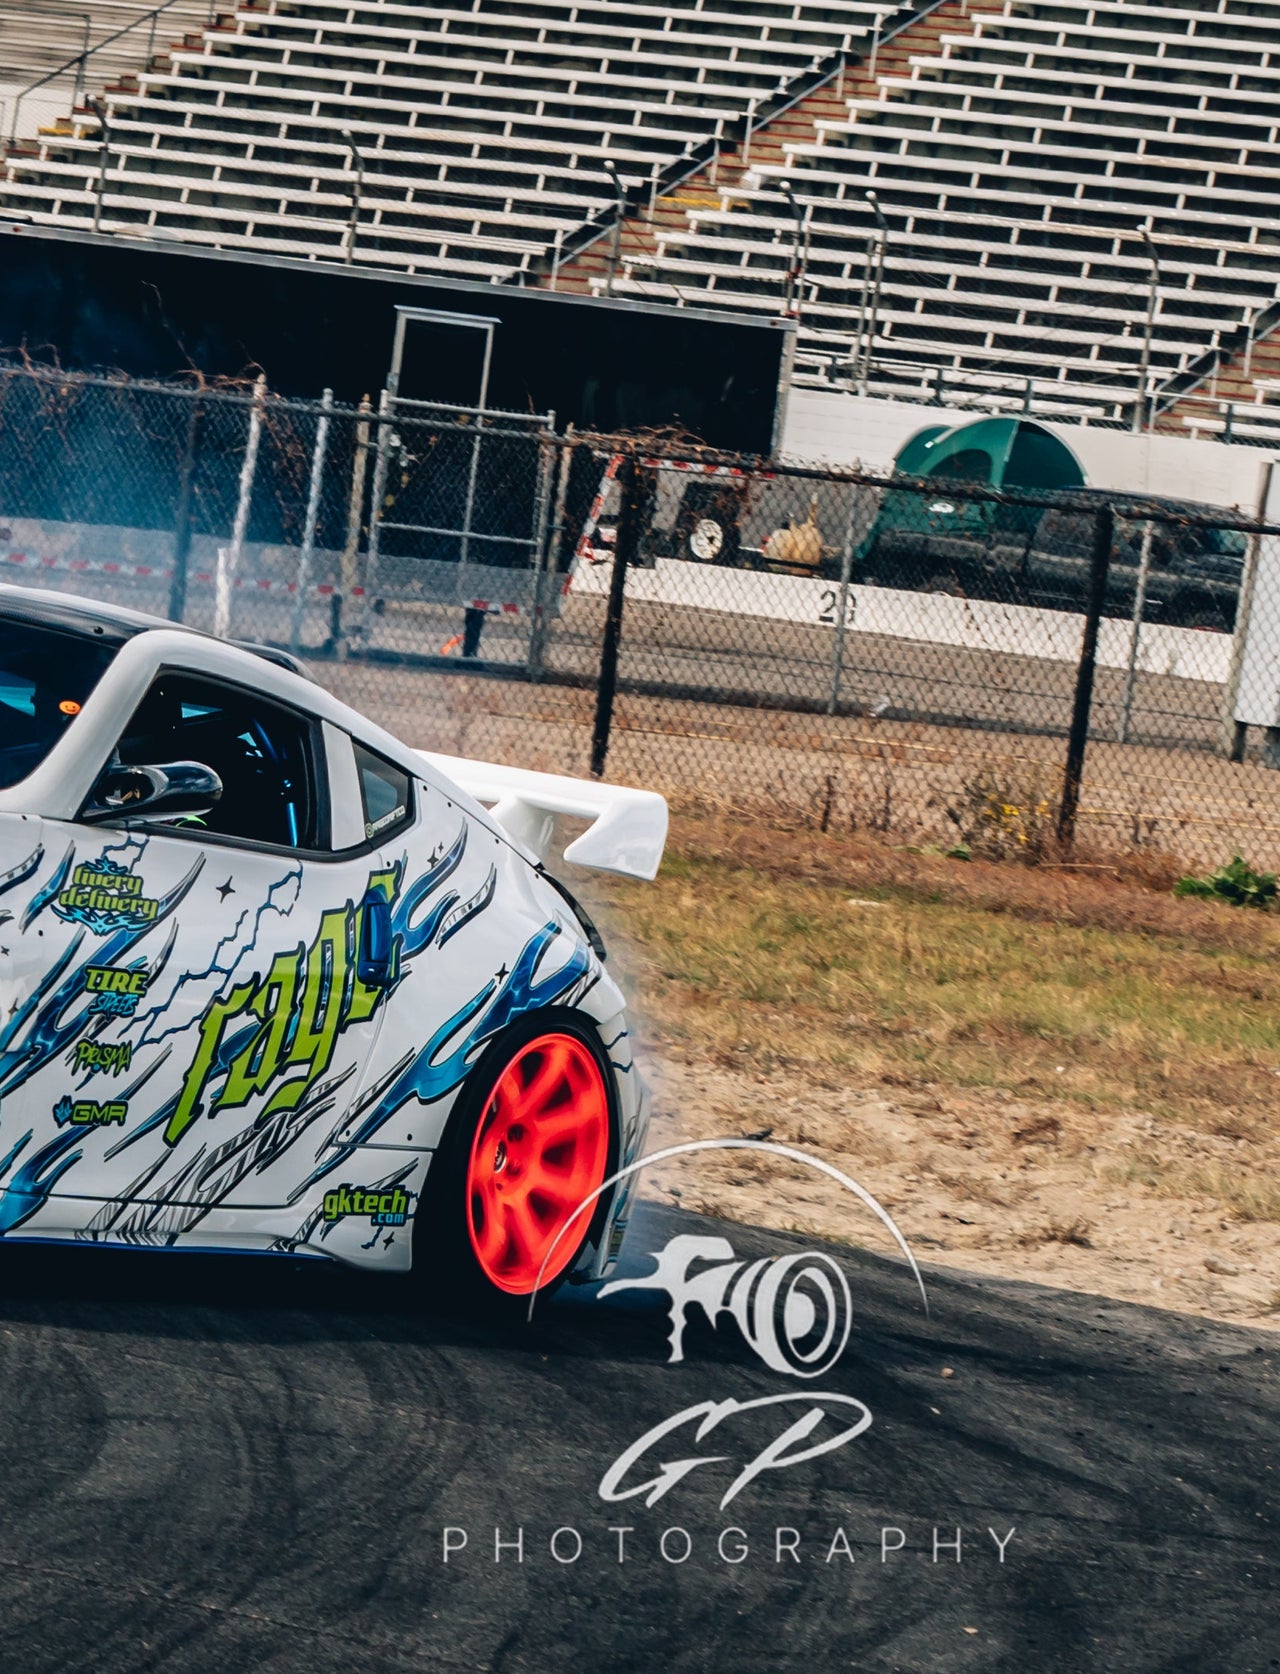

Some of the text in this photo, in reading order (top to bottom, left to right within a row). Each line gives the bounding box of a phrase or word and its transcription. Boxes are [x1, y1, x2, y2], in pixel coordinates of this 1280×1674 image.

[73, 866, 143, 896] livery
[59, 886, 159, 922] delivery
[86, 968, 148, 995] TIRE
[72, 1104, 127, 1122] GMR
[324, 1188, 407, 1220] gktech
[372, 1213, 404, 1224] .com
